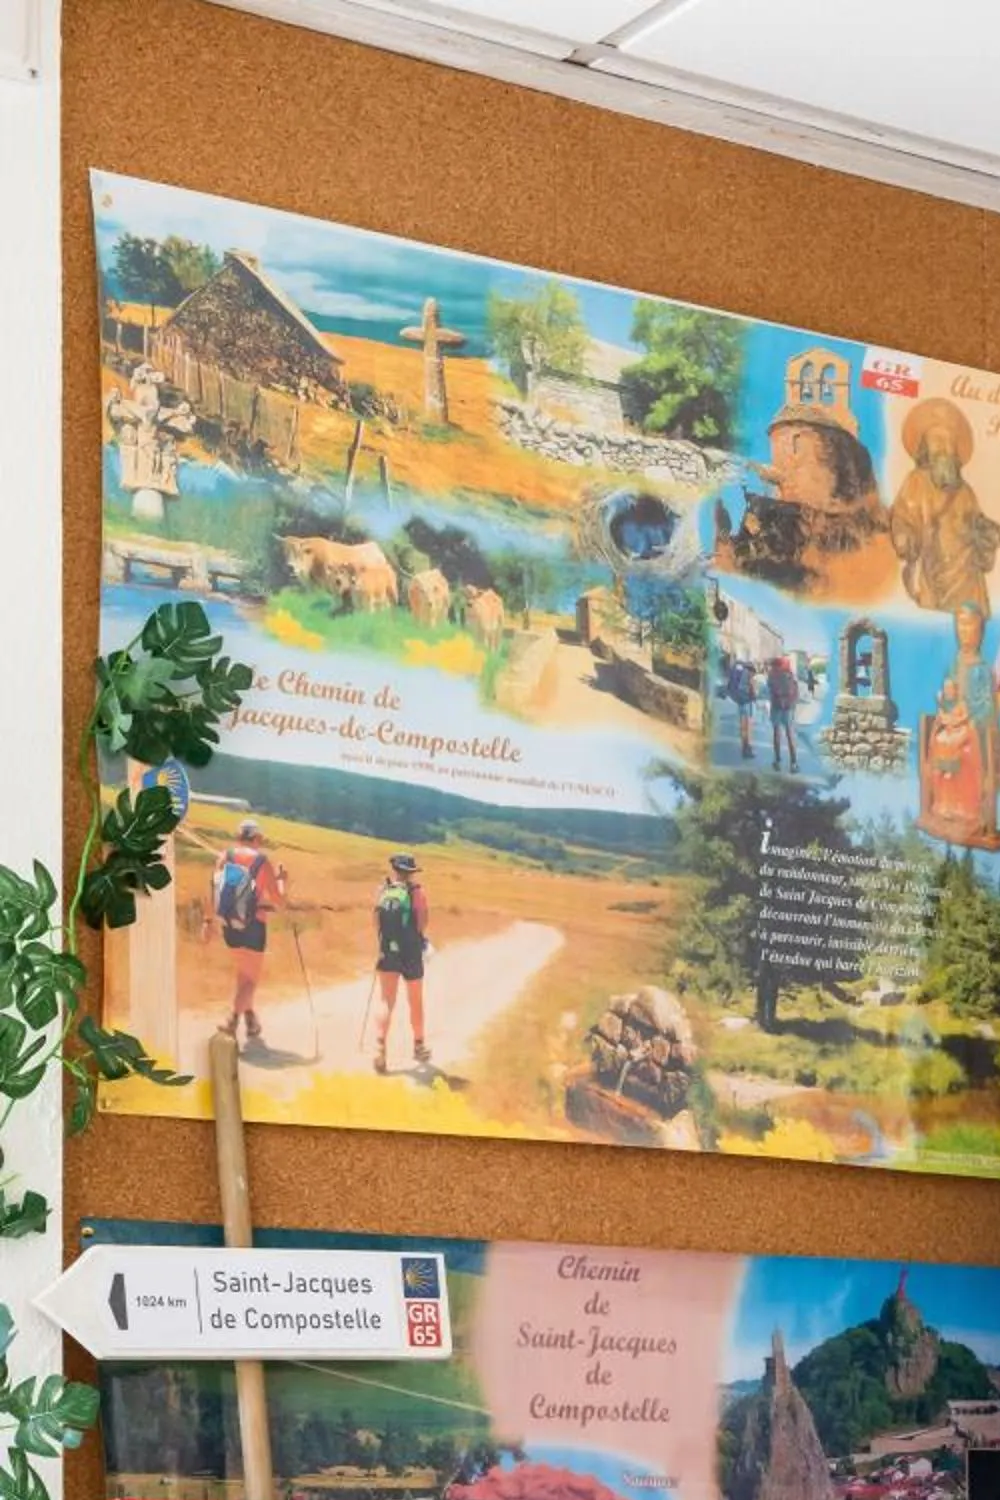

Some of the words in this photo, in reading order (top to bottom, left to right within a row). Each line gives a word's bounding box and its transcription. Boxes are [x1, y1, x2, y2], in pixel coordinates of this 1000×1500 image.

[876, 373, 904, 391] 65
[950, 375, 982, 401] Au
[277, 669, 366, 706] Chemin
[373, 684, 402, 710] de
[760, 883, 773, 897] de
[776, 886, 806, 900] Saint
[814, 955, 833, 972] qui
[557, 1255, 641, 1282] Chemin
[212, 1270, 374, 1297] Saint-Jacques
[135, 1295, 165, 1308] 1024
[168, 1295, 187, 1308] km
[409, 1303, 438, 1322] GR
[584, 1292, 610, 1314] de
[210, 1308, 236, 1330] de
[245, 1307, 382, 1334] Compostelle
[413, 1325, 438, 1345] 65
[516, 1322, 677, 1358] Saint-Jacques
[585, 1362, 612, 1385] de
[529, 1392, 671, 1427] Compostelle
